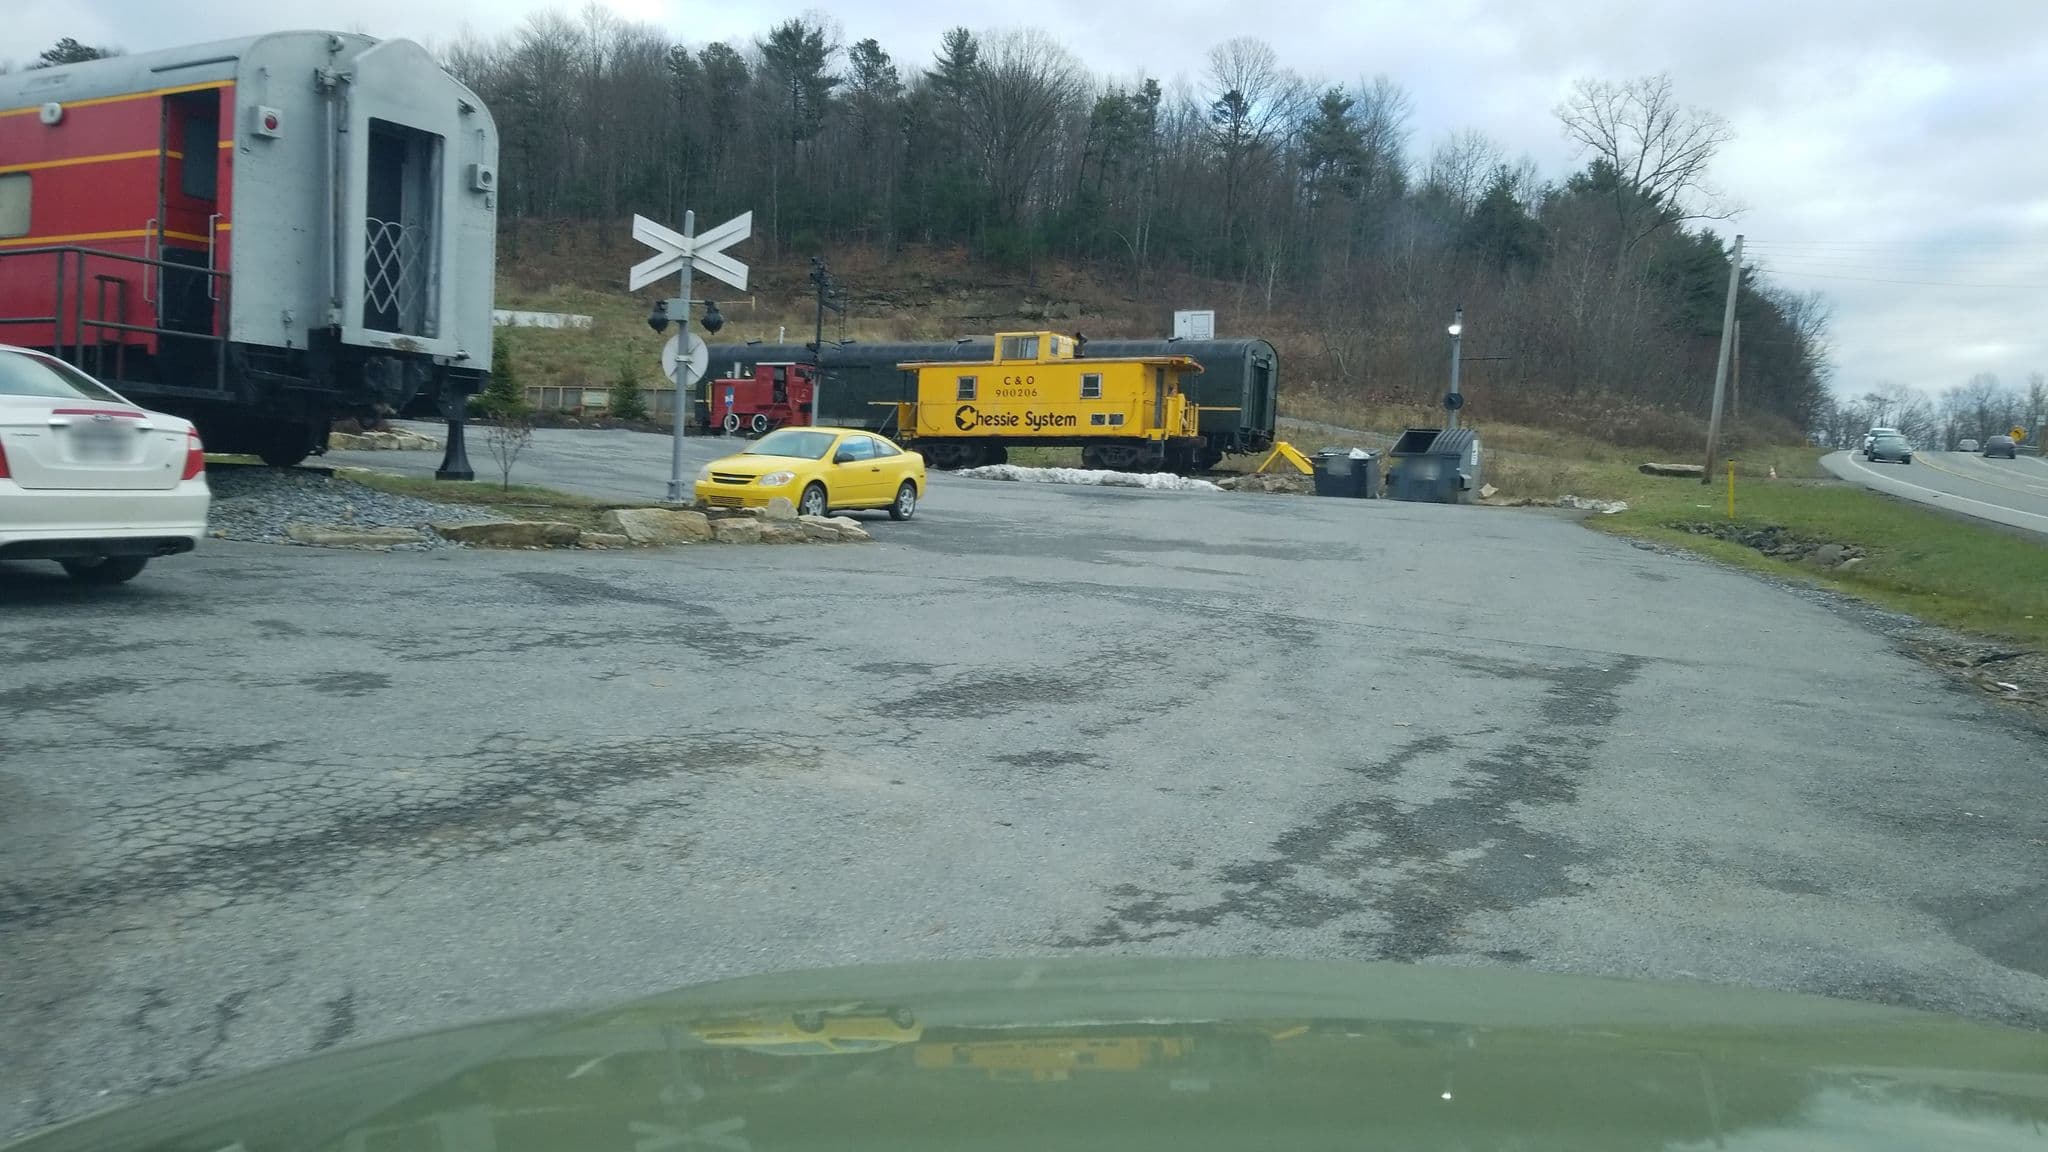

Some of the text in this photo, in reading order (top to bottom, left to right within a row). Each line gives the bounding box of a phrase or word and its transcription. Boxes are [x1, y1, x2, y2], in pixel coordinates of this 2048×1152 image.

[1004, 376, 1035, 386] C & O
[995, 388, 1038, 398] 900206
[955, 405, 1077, 431] Chessie System
